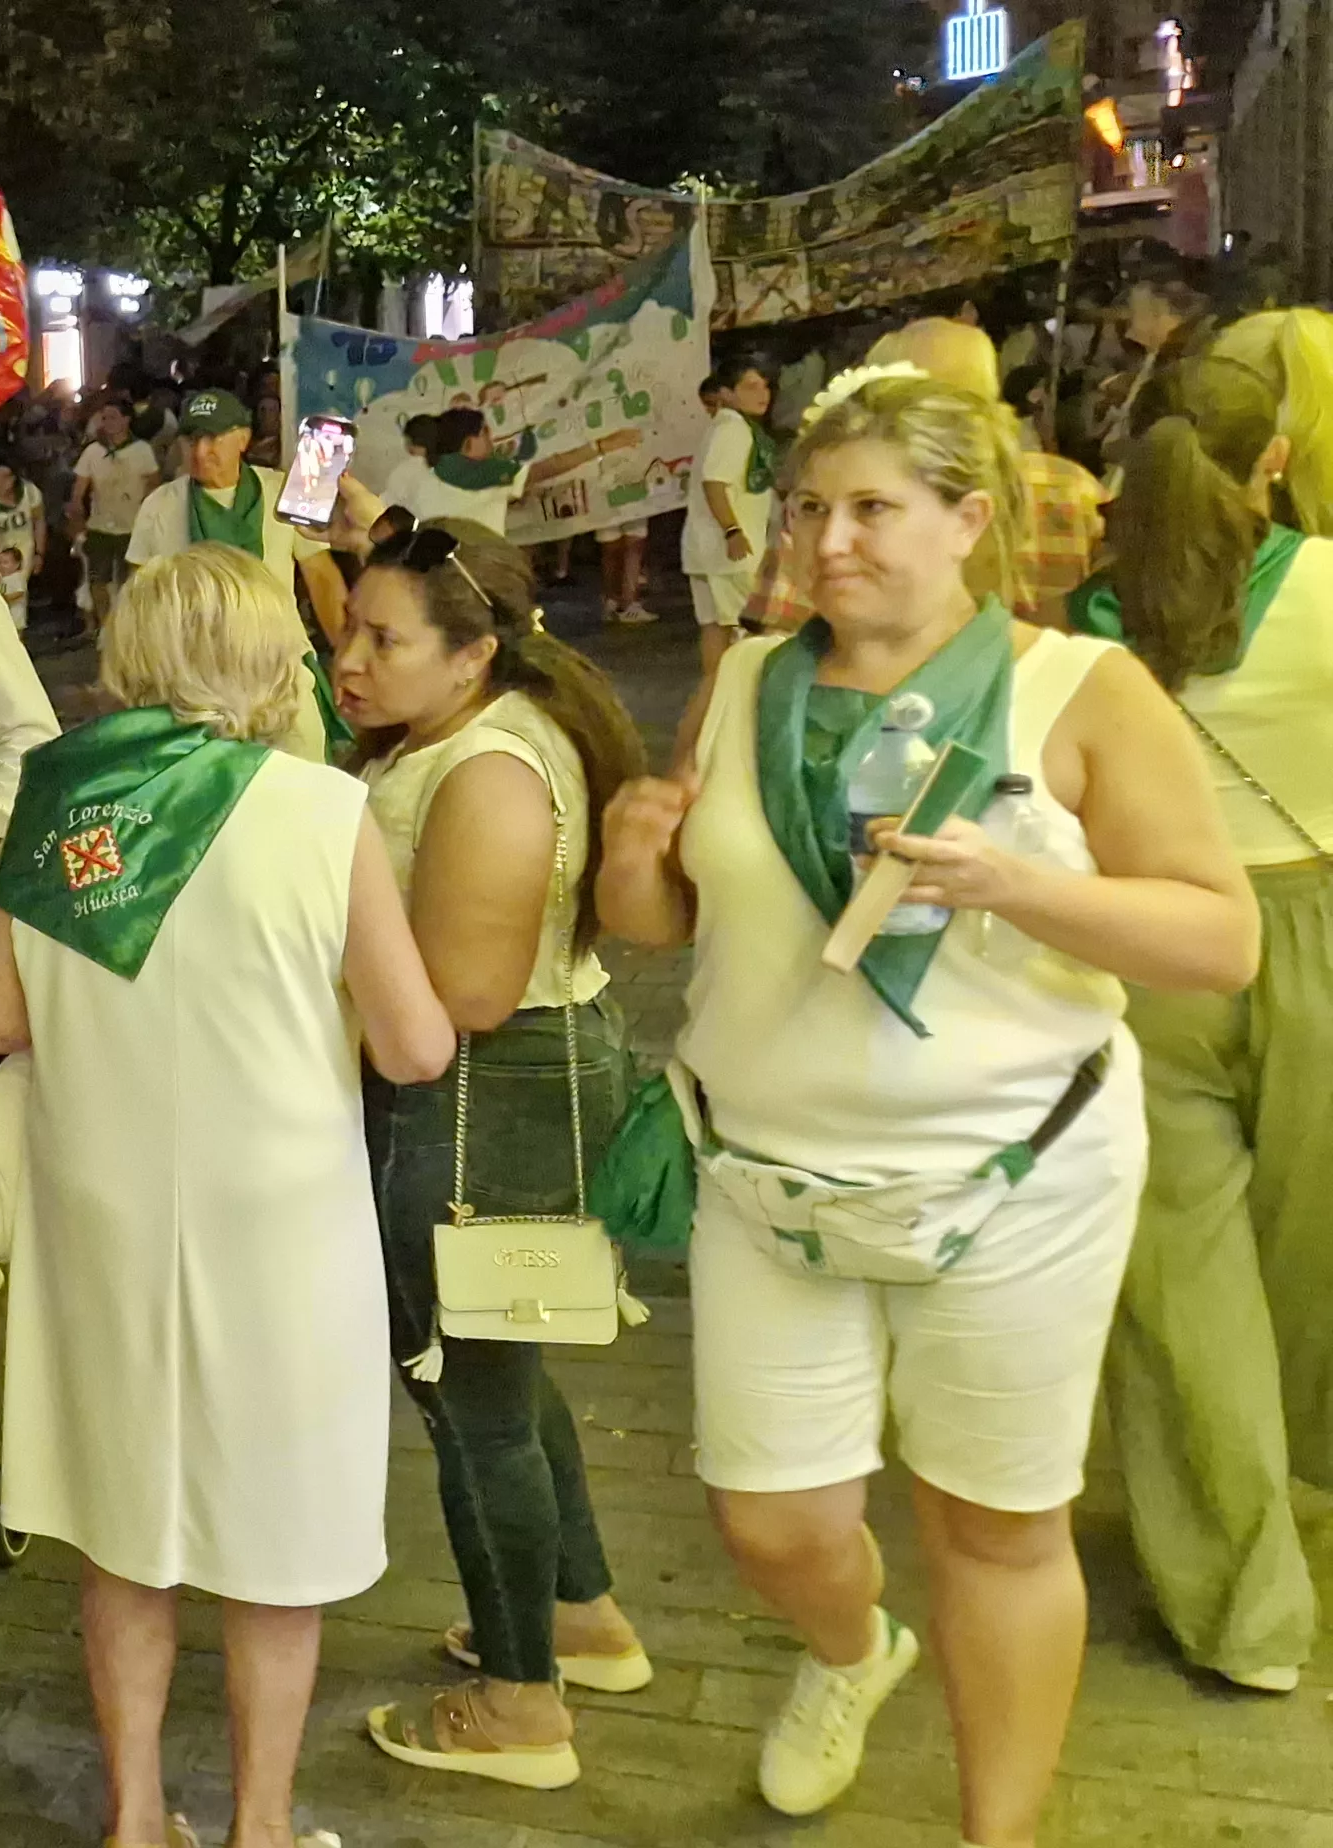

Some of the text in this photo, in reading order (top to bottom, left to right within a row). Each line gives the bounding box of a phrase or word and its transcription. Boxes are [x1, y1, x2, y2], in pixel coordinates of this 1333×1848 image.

[33, 802, 154, 869] San Lorenzo
[73, 883, 143, 919] Huesca
